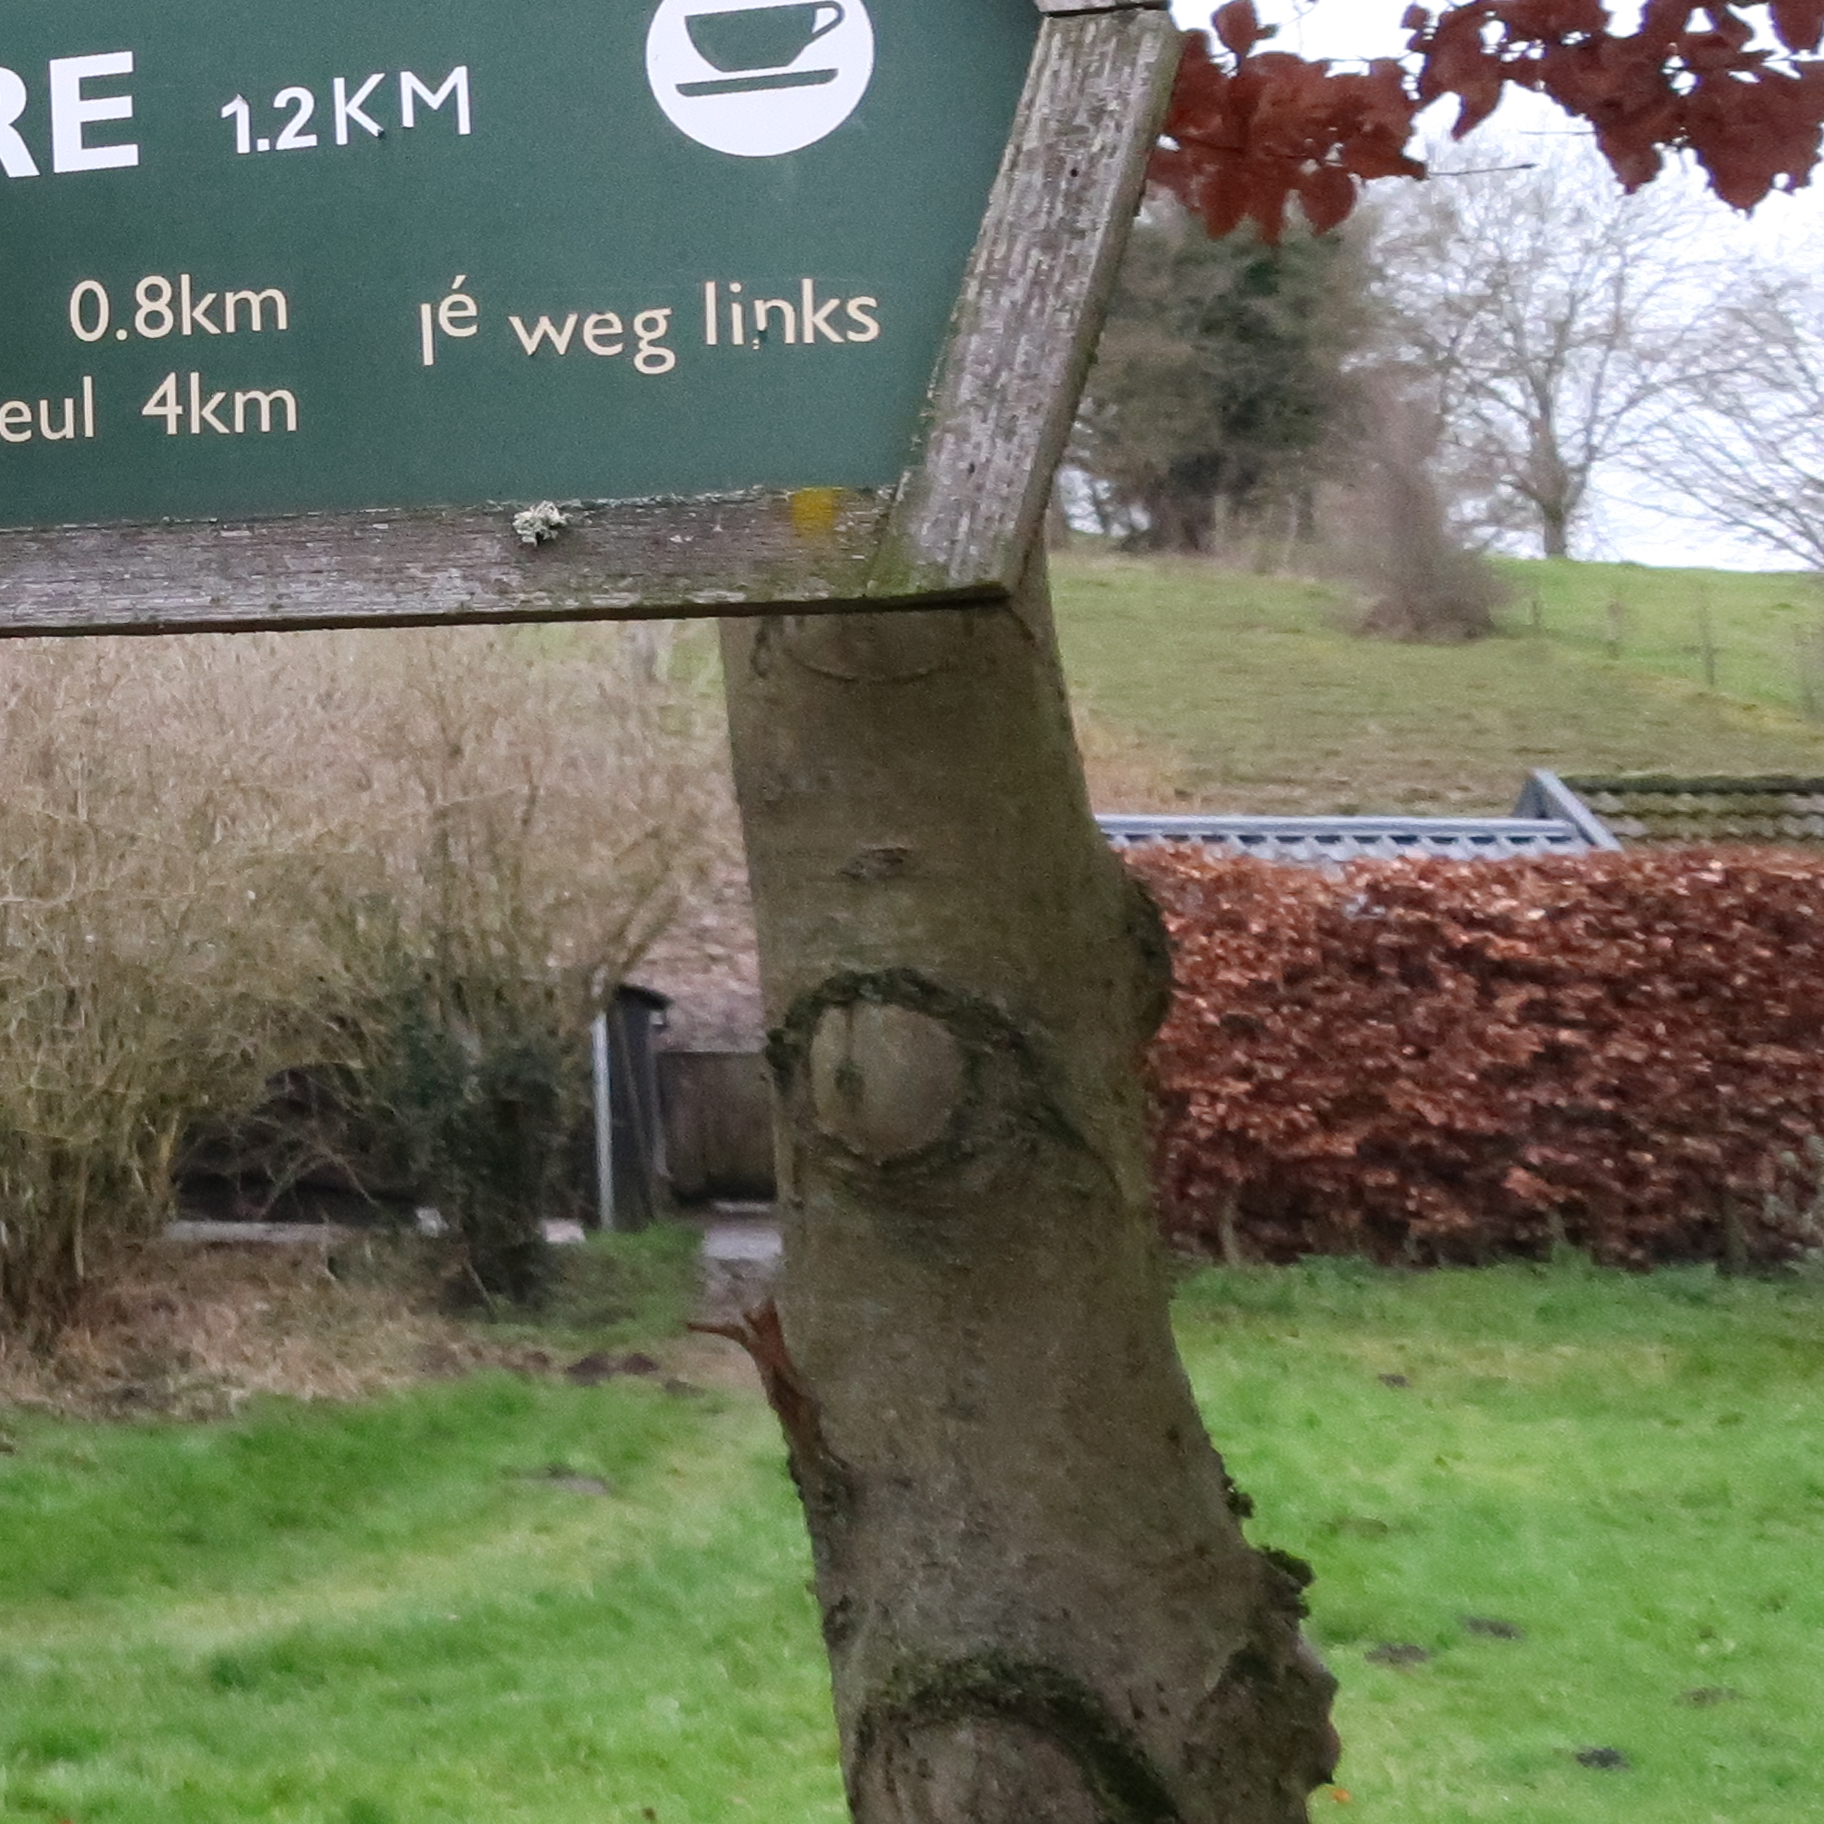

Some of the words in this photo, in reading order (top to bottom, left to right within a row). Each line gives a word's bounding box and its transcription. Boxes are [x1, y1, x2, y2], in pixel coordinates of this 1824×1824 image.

[69, 273, 288, 342] 0.8km
[508, 307, 676, 375] weg
[704, 277, 880, 346] links
[141, 371, 297, 435] 4km
